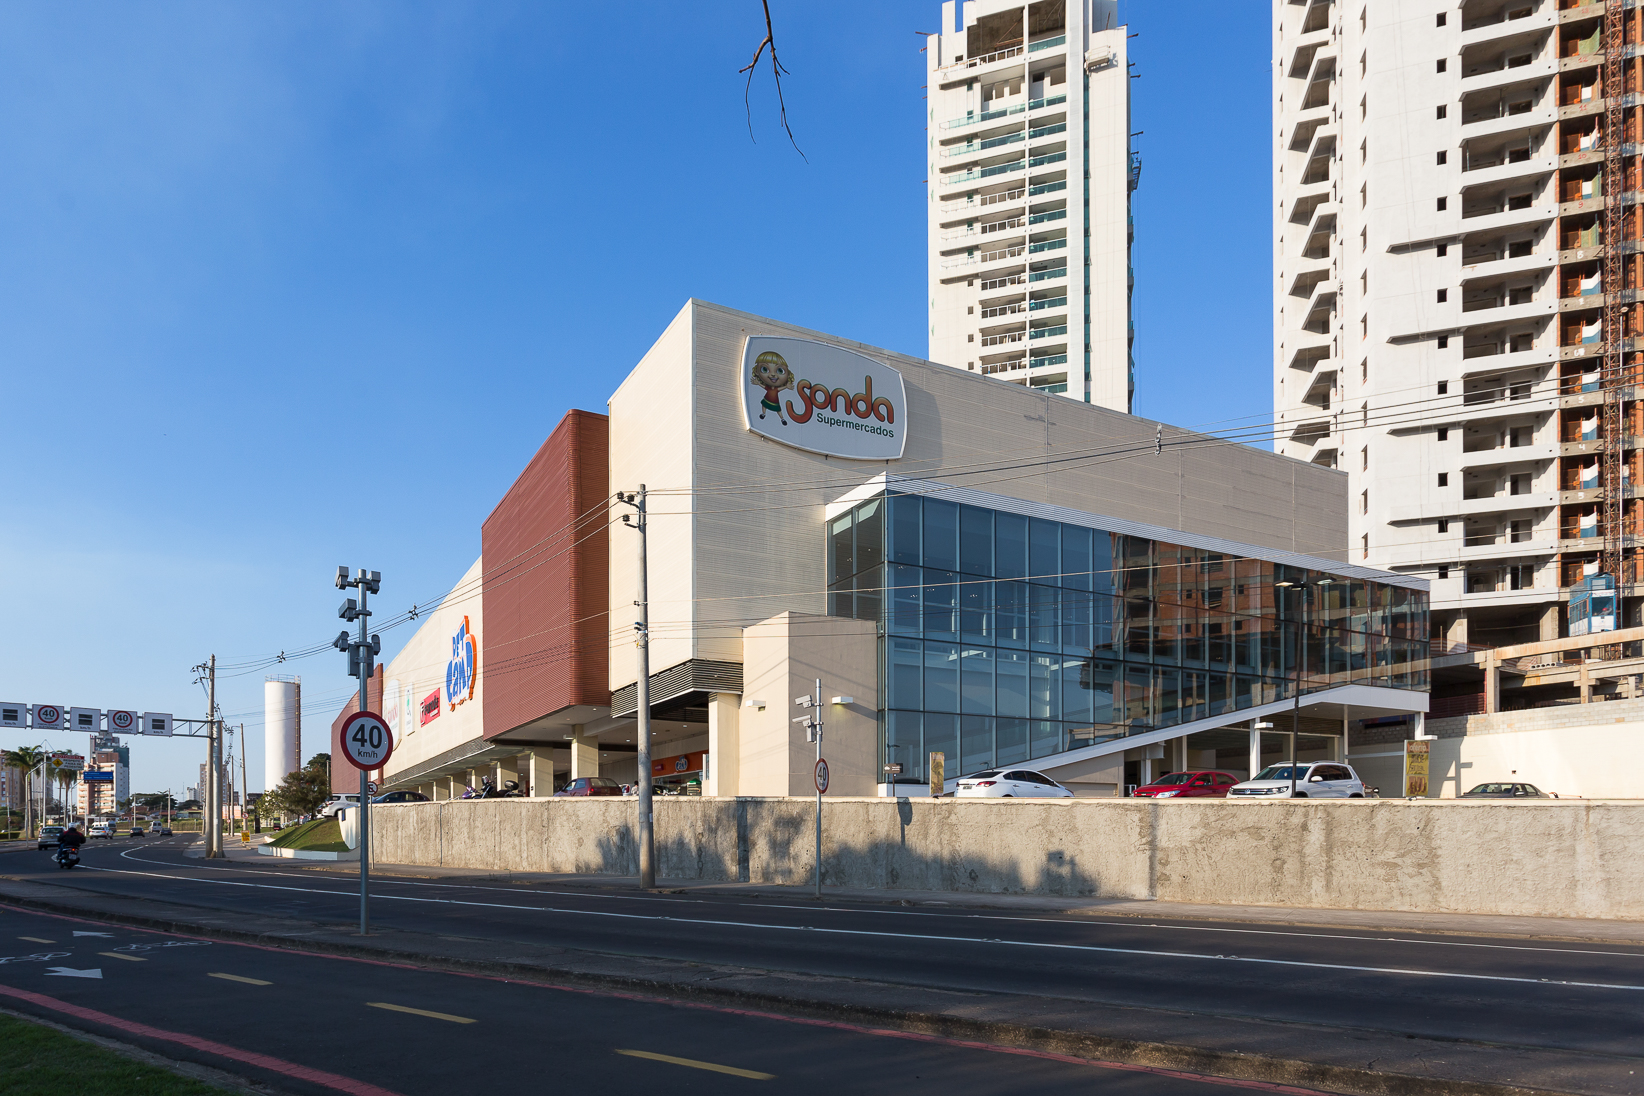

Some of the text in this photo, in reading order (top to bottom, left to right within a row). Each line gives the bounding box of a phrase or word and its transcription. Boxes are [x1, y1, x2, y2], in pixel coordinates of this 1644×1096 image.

[786, 375, 894, 424] Sonda
[816, 412, 894, 438] Supermercados
[42, 709, 55, 718] 40
[116, 714, 129, 722] 40
[352, 724, 383, 749] 40
[818, 766, 827, 781] 40
